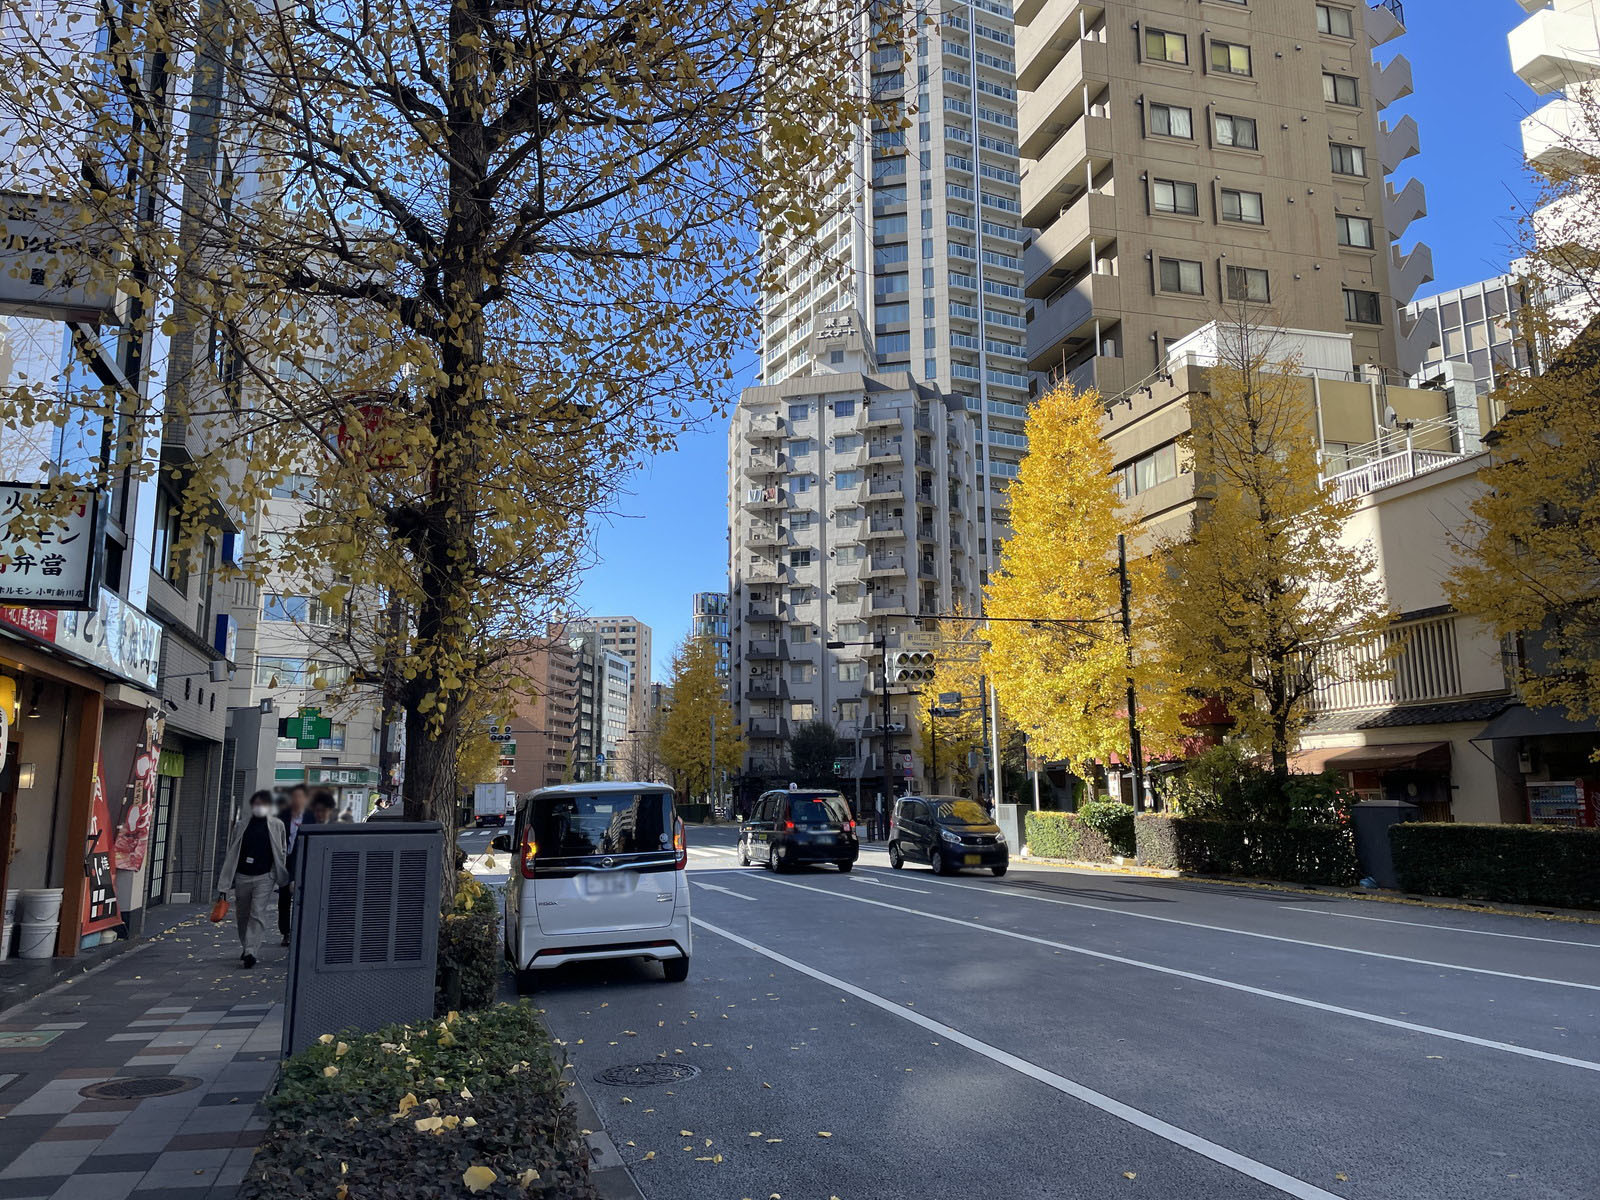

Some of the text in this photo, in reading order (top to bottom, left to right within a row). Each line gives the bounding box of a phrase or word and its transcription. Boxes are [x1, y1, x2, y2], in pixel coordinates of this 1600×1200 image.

[816, 327, 856, 338] エステート
[36, 588, 84, 598] 小町新川店
